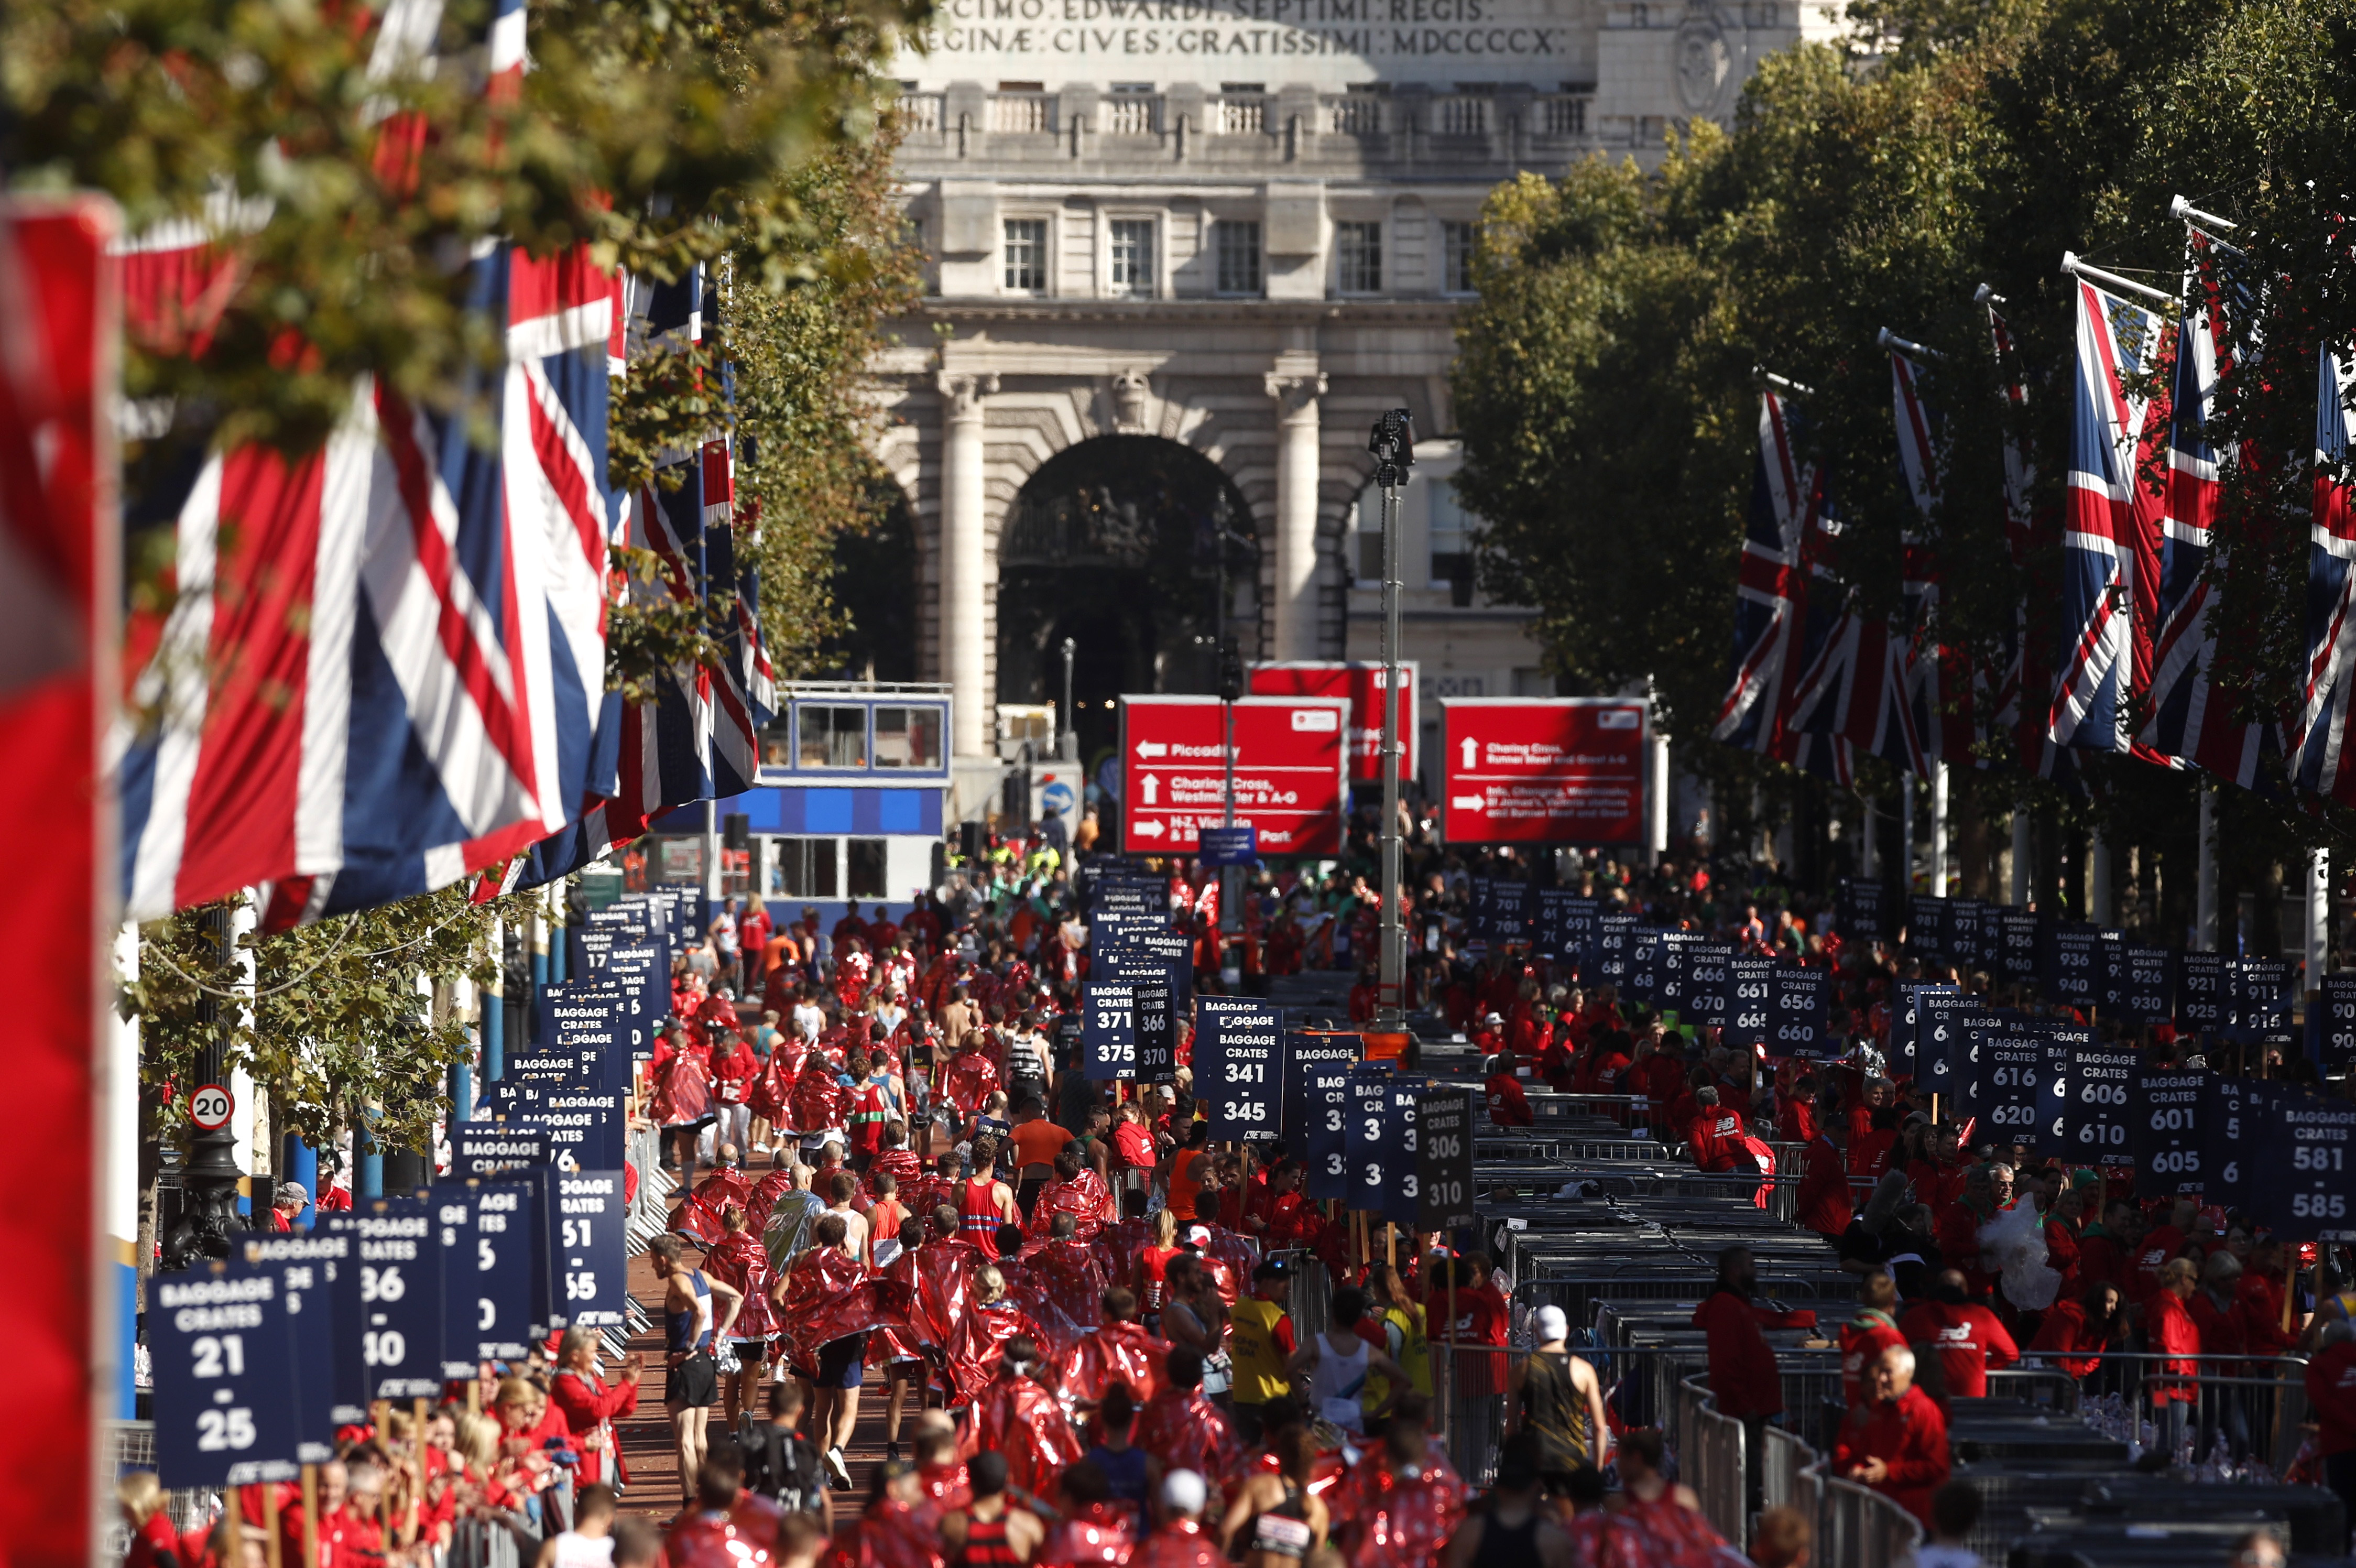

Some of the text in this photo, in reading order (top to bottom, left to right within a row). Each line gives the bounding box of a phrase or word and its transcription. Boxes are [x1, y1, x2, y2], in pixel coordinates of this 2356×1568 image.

[1171, 742, 1241, 762] Piccadily
[1170, 790, 1255, 804] Westmiter
[1197, 816, 1252, 829] Victria
[1259, 831, 1292, 843] Park
[1565, 918, 1591, 930] 691
[1915, 914, 1939, 927] 981
[1955, 918, 1977, 931] 971
[1144, 937, 1188, 947] BAGGAGE
[2006, 934, 2033, 948] 956
[2057, 932, 2095, 942] BAGGAGE
[1688, 945, 1732, 954] BAGGAGE
[2061, 942, 2090, 951] CRATES
[2128, 949, 2168, 957] BAGGAGE
[613, 949, 655, 959] BAGGAGE
[1694, 955, 1725, 964] CRATES
[2060, 952, 2090, 967] 936
[2184, 955, 2220, 964] BAGGAG
[2005, 957, 2032, 971] 960
[2132, 959, 2163, 967] CRATES
[2242, 963, 2286, 972] BAGGAGE
[1693, 967, 1725, 982] 666
[1776, 970, 1823, 981] BAGGAGE
[2132, 969, 2163, 984] 926
[1737, 983, 1768, 998] 661
[1781, 981, 1816, 991] CRATES
[2058, 978, 2088, 993] 940
[2188, 976, 2216, 991] 921
[1090, 987, 1133, 996] BAGGAG
[1138, 988, 1168, 999] BAGGAGE
[2248, 985, 2278, 1000] 911
[1097, 998, 1133, 1007] CRATES
[1141, 1000, 1165, 1010] CRATES
[1692, 996, 1725, 1011] 670
[1780, 994, 1815, 1010] 656
[1928, 999, 1979, 1008] BAGGAGE
[2131, 996, 2162, 1010] 930
[554, 1008, 608, 1018] BAGGAGE
[2186, 1004, 2217, 1018] 925
[2332, 1003, 2355, 1019] 90
[561, 1020, 602, 1029] CRATES
[1097, 1011, 1131, 1029] 371
[1142, 1014, 1166, 1032] 366
[1964, 1018, 2002, 1027] BAGGA
[2248, 1014, 2281, 1028] 915
[1219, 1035, 1275, 1046] BAGGAGE
[1778, 1025, 1814, 1042] 660
[1987, 1037, 2038, 1049] BAGGAG
[1098, 1044, 1136, 1062] 375
[1143, 1048, 1166, 1065] 370
[1226, 1048, 1268, 1059] CRATES
[1295, 1049, 1354, 1060] BAGGAGE
[1994, 1051, 2037, 1062] CRATES
[2076, 1052, 2136, 1065] BAGGAGE
[514, 1059, 574, 1069] BAGGAGE
[1225, 1063, 1264, 1083] 341
[1993, 1067, 2037, 1086] 616
[2082, 1067, 2128, 1079] CRATES
[2141, 1075, 2205, 1089] BAGGAGE
[2081, 1083, 2127, 1105] 606
[2149, 1091, 2197, 1103] CRATES
[197, 1097, 227, 1116] 20
[549, 1096, 615, 1108] BAGGAGE
[1422, 1097, 1465, 1115] BAGGAGE
[1224, 1101, 1266, 1121] 345
[1991, 1105, 2035, 1125] 620
[2285, 1109, 2356, 1125] BAGGAGE
[1427, 1115, 1460, 1130] CRATES
[2150, 1108, 2195, 1130] 601
[2079, 1123, 2125, 1145] 610
[2294, 1127, 2349, 1141] CRATES
[462, 1141, 540, 1157] BAGGAGE
[1427, 1134, 1461, 1160] 306
[2152, 1150, 2200, 1173] 605
[2293, 1146, 2343, 1172] 581
[1429, 1180, 1462, 1206] 310
[2292, 1193, 2347, 1218] 585
[159, 1277, 275, 1308] BAGGAGE
[174, 1303, 263, 1333] CRATES
[191, 1334, 245, 1378] 21
[195, 1407, 257, 1452] 25
